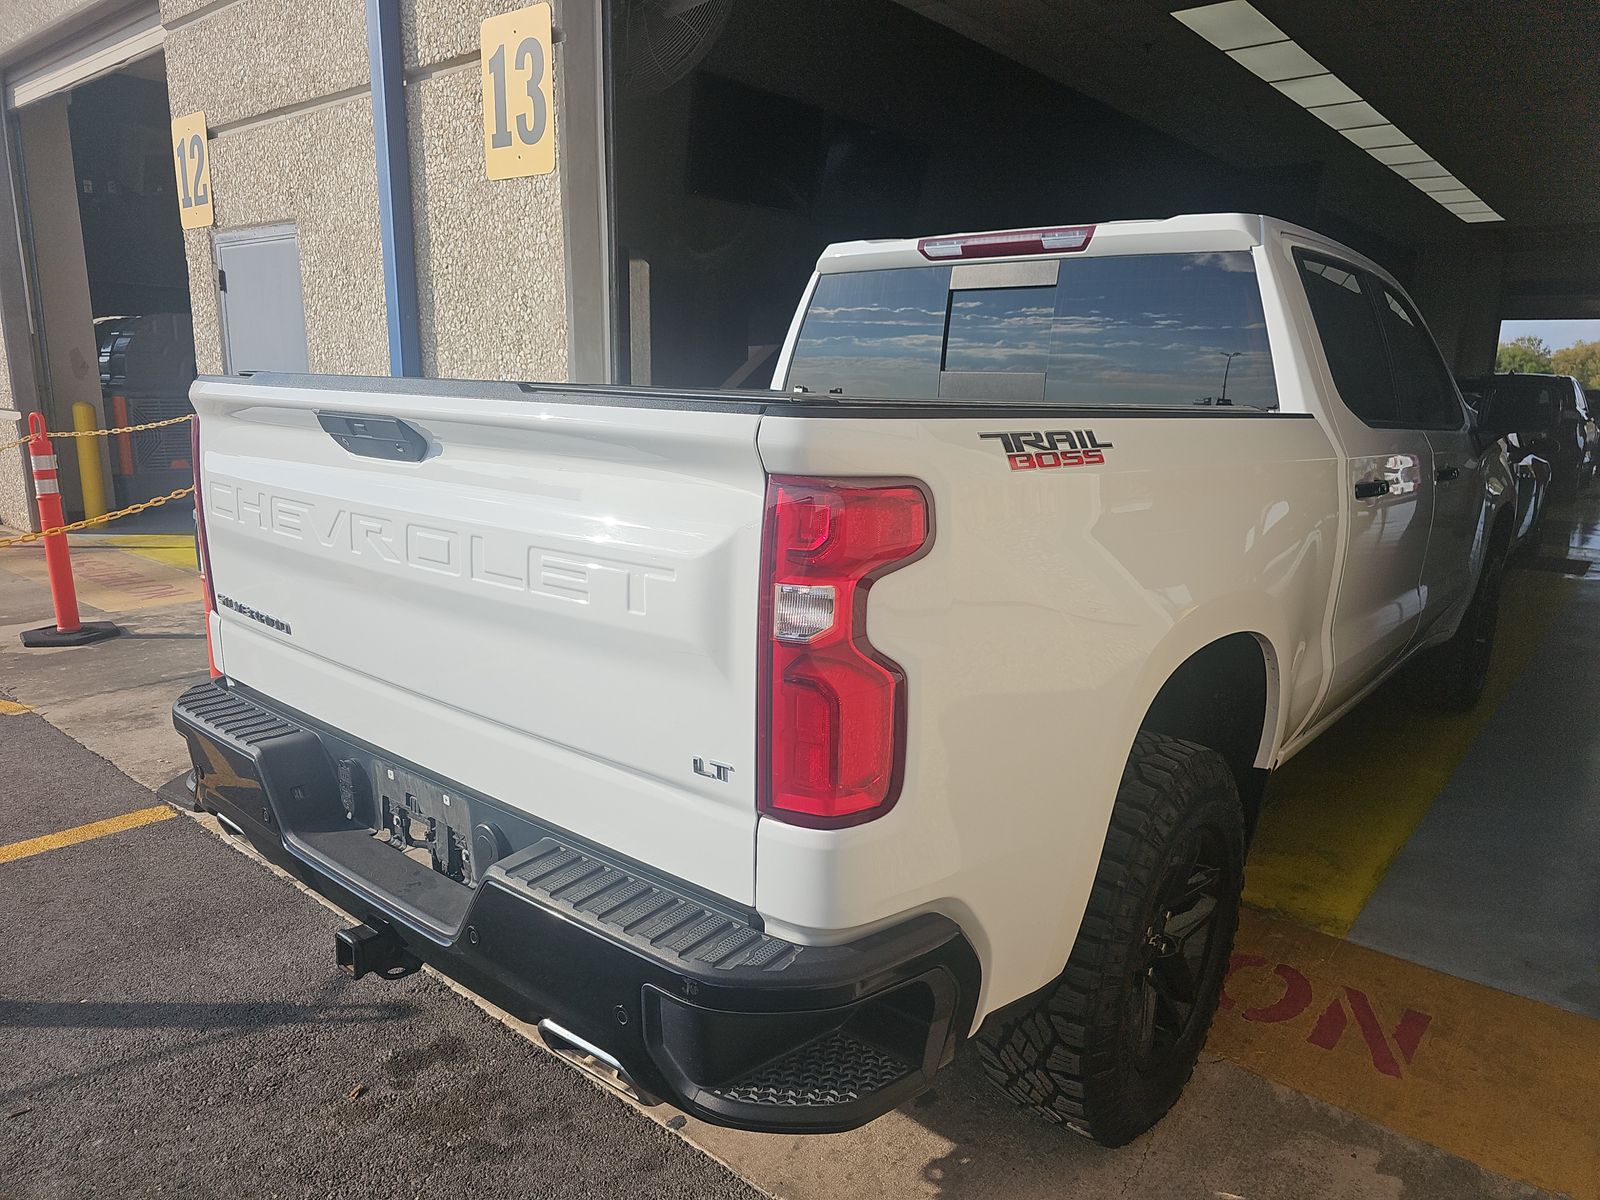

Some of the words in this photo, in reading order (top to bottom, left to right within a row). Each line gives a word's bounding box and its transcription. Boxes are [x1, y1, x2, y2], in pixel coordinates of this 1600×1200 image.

[488, 37, 547, 149] 13
[176, 134, 209, 208] 12
[978, 430, 1115, 453] TRAIL
[1006, 449, 1106, 472] BOSS
[209, 481, 678, 617] CHEVROLET
[692, 756, 736, 783] LT
